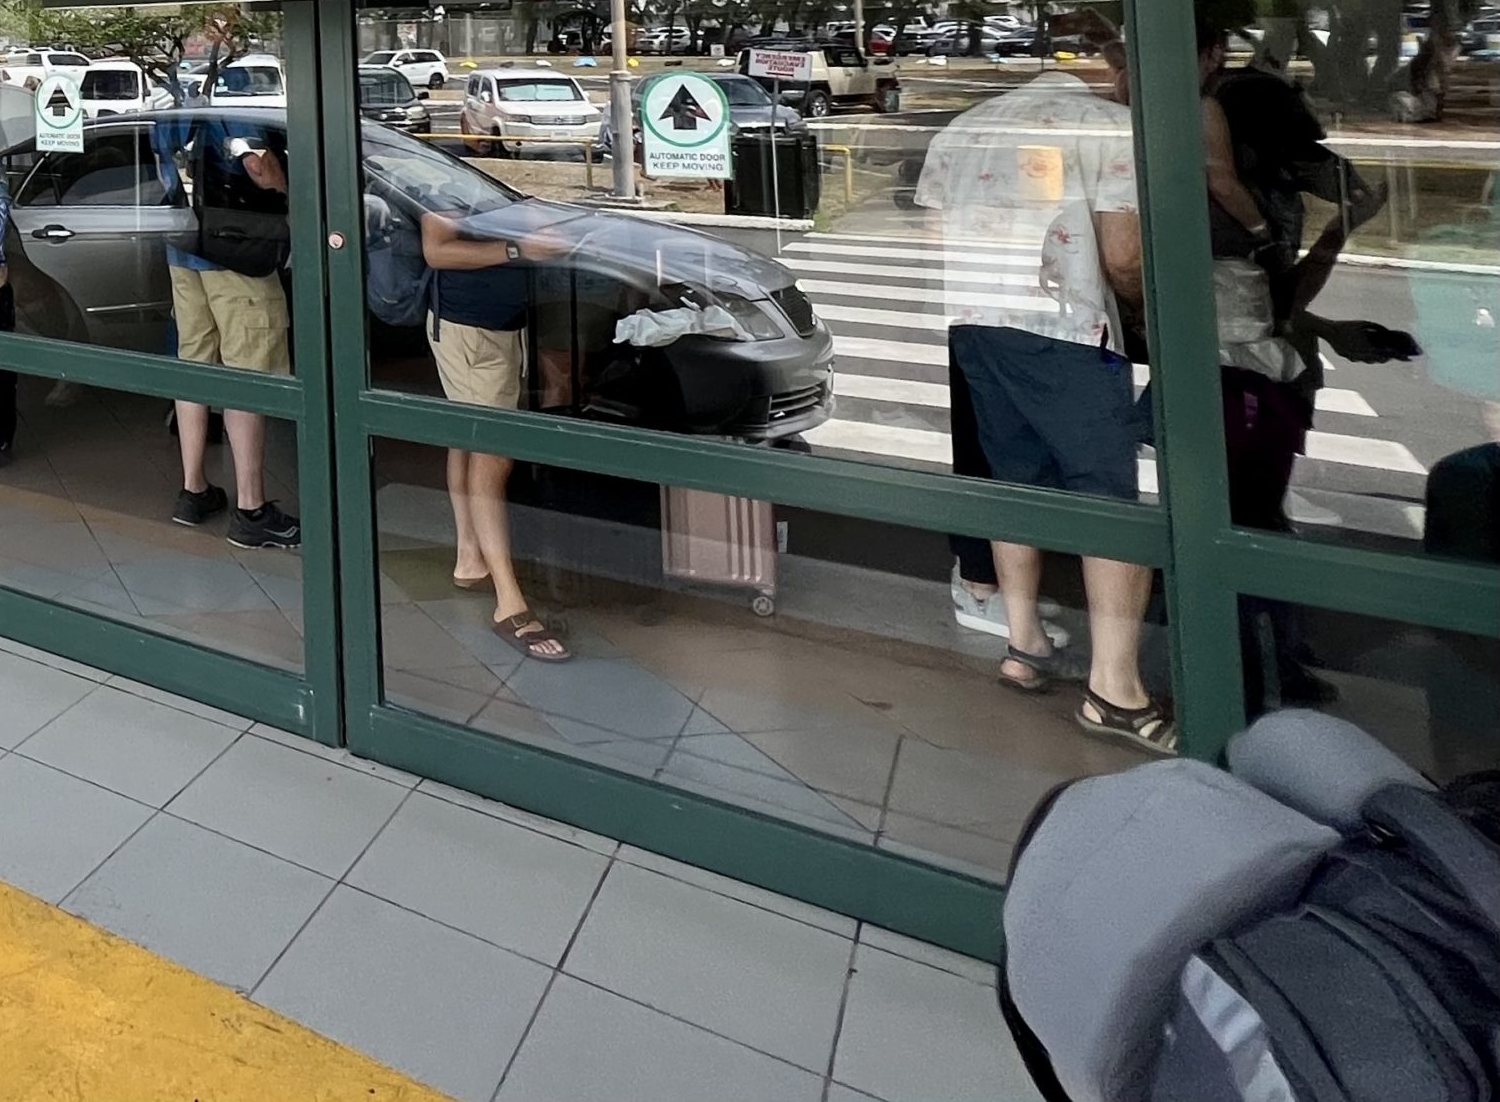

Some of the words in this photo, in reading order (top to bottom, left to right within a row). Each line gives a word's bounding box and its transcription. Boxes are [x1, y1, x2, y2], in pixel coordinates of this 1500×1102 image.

[649, 152, 697, 160] AUTOMATIC
[653, 162, 679, 170] KEEP
[682, 162, 723, 171] MOVING
